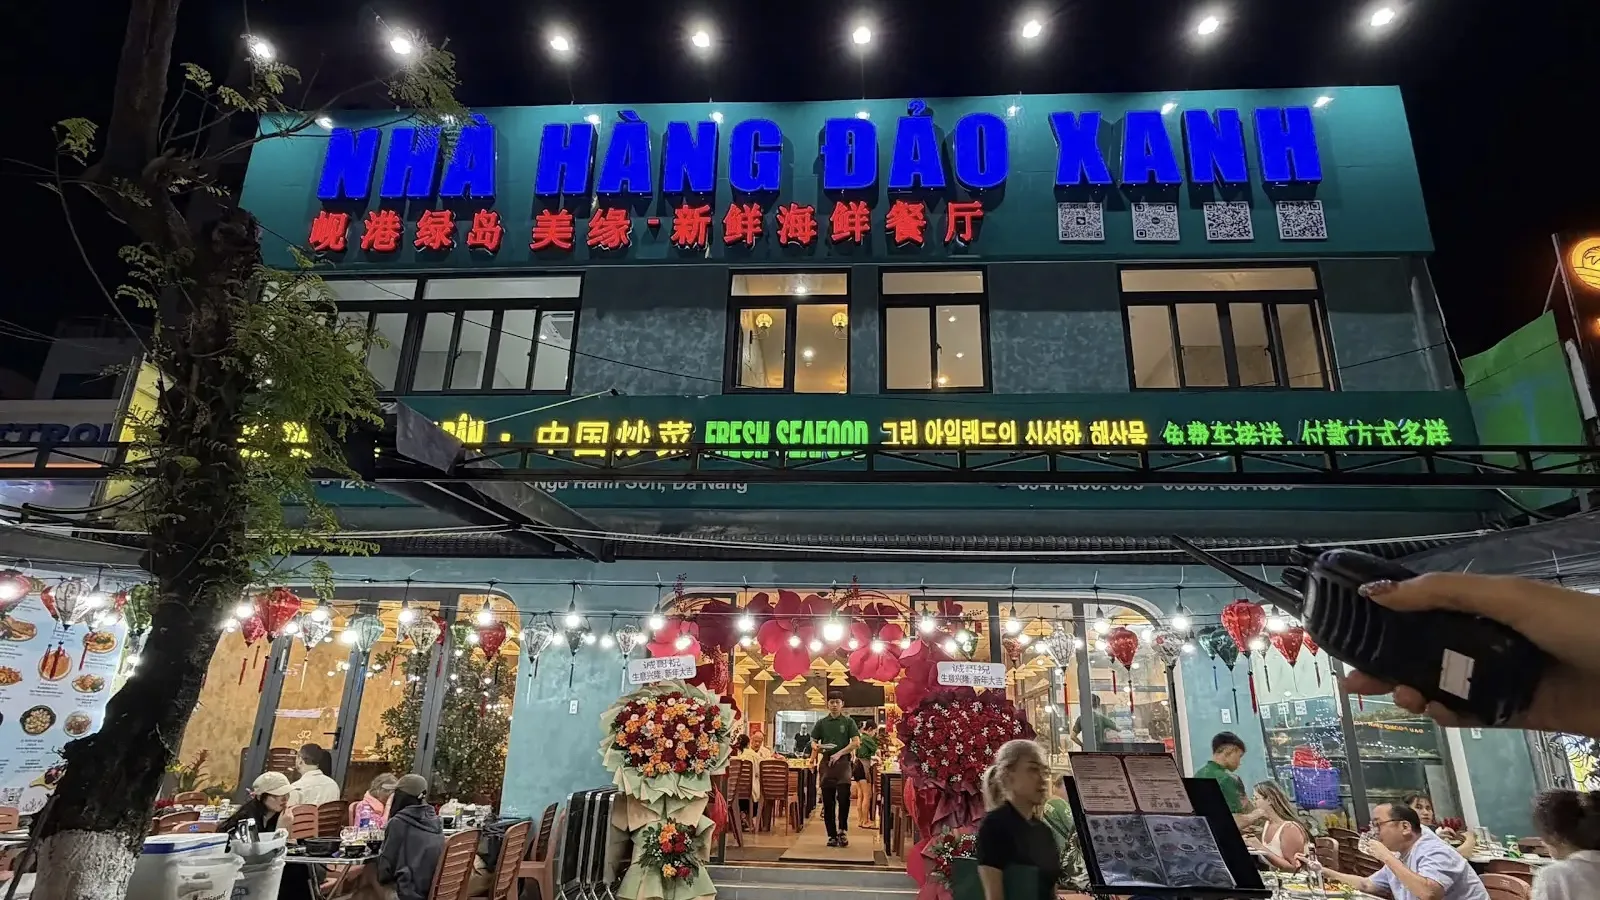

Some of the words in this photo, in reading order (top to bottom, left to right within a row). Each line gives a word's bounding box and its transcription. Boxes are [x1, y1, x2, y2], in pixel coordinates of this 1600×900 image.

[316, 114, 497, 200] NHÀ
[535, 110, 784, 197] HÀNG
[821, 99, 1010, 192] ĐẢO
[1049, 106, 1323, 186] XANH
[308, 208, 504, 254] 岘港绿岛
[536, 419, 693, 457] 中国炒菜
[704, 420, 770, 459] FRESH
[776, 419, 869, 459] SEAFOOD
